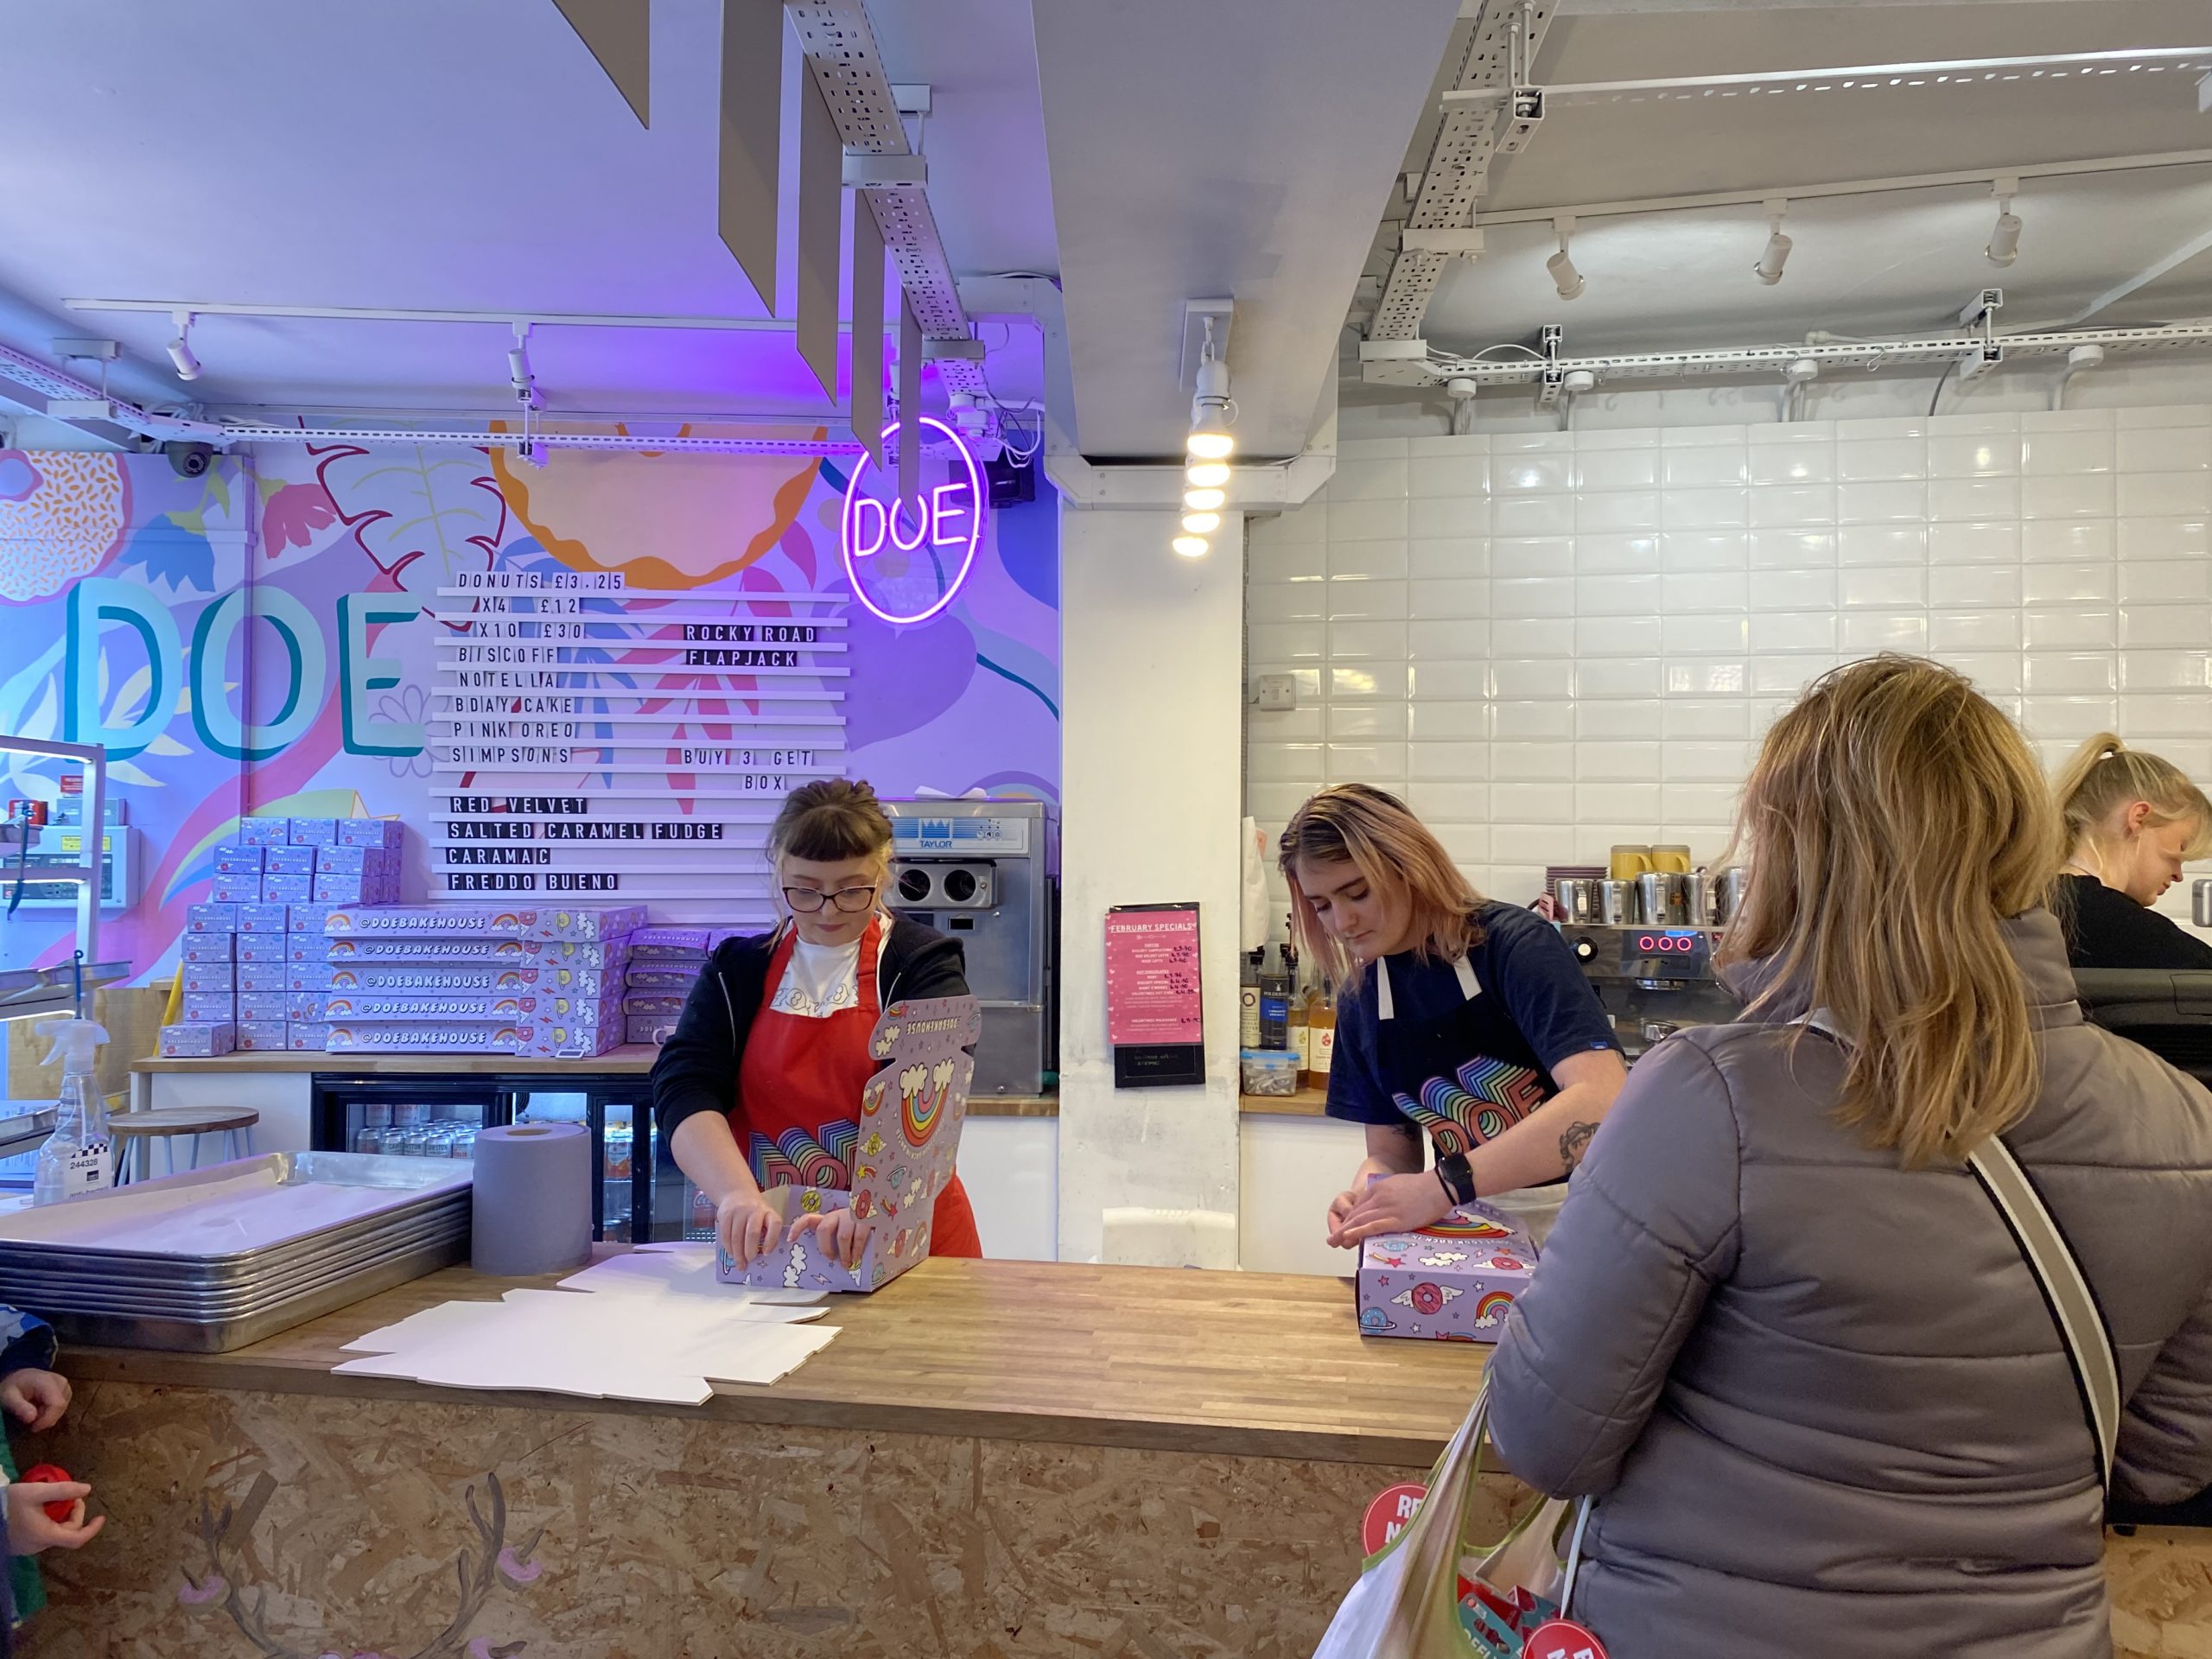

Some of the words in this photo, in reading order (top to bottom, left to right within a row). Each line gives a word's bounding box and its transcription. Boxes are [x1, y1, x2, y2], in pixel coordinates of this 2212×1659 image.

[855, 483, 969, 557] DOE
[459, 574, 541, 589] DONUTS
[555, 575, 621, 590] £3.25
[482, 598, 506, 613] X4
[541, 599, 576, 613] £12
[480, 623, 518, 638] X10
[544, 623, 582, 639] £30
[687, 626, 752, 641] ROCKY
[766, 626, 815, 642] ROAD
[459, 647, 555, 663] BISCOFF
[690, 651, 795, 666] FLAPJACK
[64, 577, 424, 762] DOE
[460, 672, 553, 687] NOTELLA
[455, 697, 508, 712] BDAY
[524, 698, 572, 713] CAKE
[454, 722, 507, 737] PINK
[522, 722, 573, 738] OREO
[453, 747, 568, 763] SIMPSONS
[684, 749, 722, 765] BUY
[742, 751, 751, 765] 3
[774, 751, 811, 766] GET
[746, 775, 783, 791] BOX
[453, 798, 490, 813] RED
[507, 798, 585, 814] VELVET
[451, 823, 532, 838] SALTED
[547, 823, 641, 839] CARAMEL
[655, 824, 721, 839] FUDGE
[919, 840, 952, 849] TAYLOR
[448, 849, 549, 864] CARAMAC
[451, 874, 533, 890] FREDDO
[550, 874, 616, 890] BUENO
[359, 917, 486, 930] @DOEBAKEHOUSE
[363, 944, 490, 956] @DOEBAKEHOUSE
[365, 975, 490, 988] @DOEBAKEHOUSE
[360, 1001, 486, 1014] @DOEBAKEHOUSE
[361, 1031, 486, 1044] @DOEBAKEHOUSE
